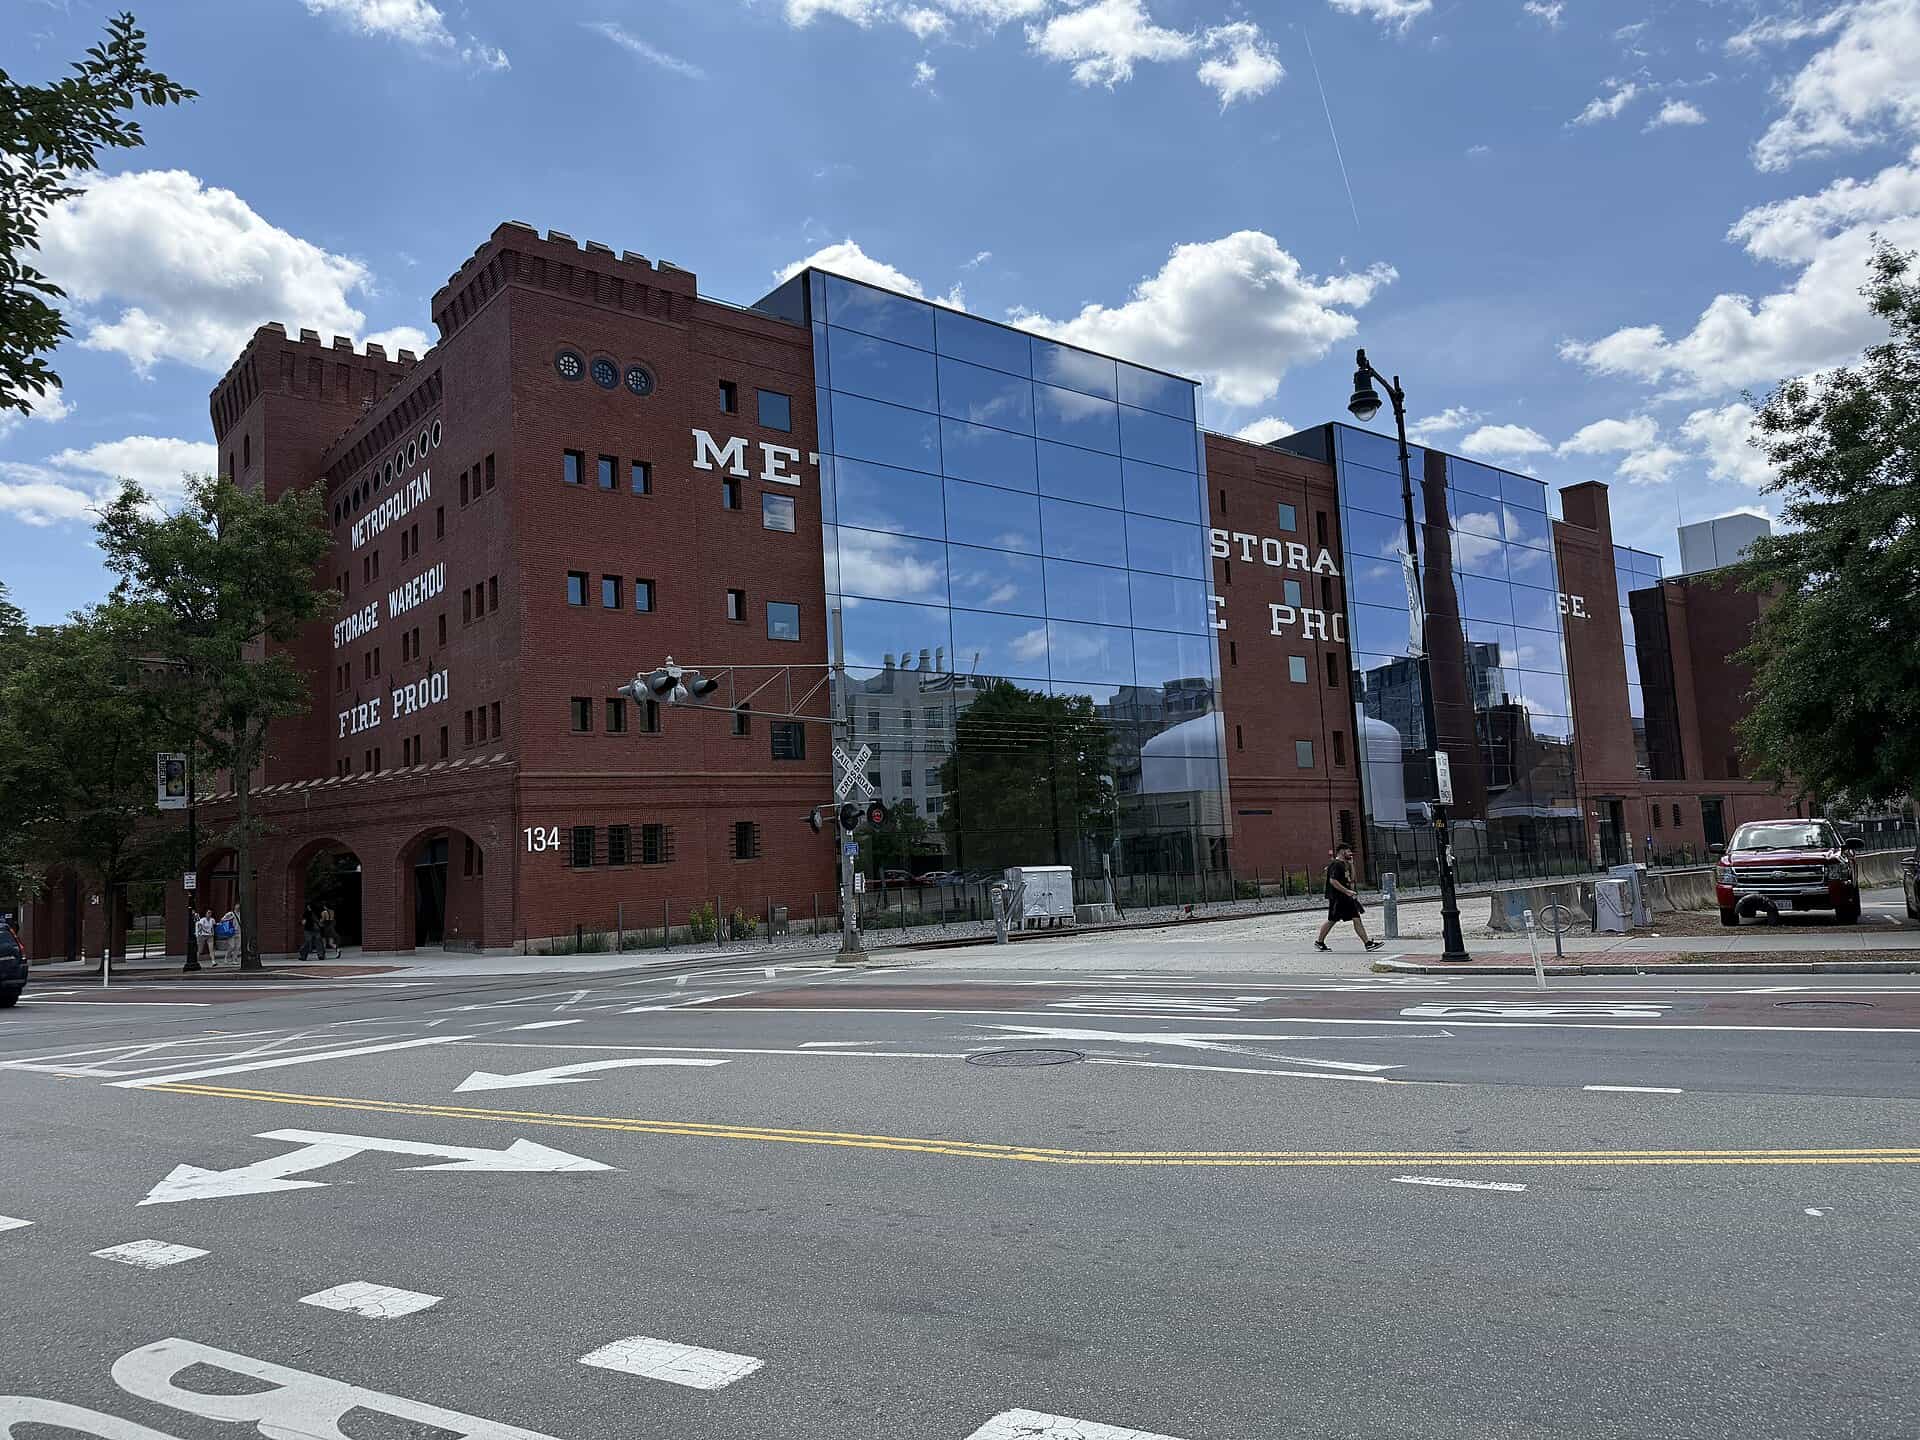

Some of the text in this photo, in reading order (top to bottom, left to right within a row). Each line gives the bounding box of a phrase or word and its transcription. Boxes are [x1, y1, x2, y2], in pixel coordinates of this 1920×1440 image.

[691, 428, 819, 486] ME
[352, 468, 432, 551] METROPOLITAN
[1210, 527, 1340, 577] STORA
[334, 561, 447, 648] STORAGE WAREHOU
[338, 697, 381, 739] FIRE
[834, 748, 851, 770] RAIL
[840, 750, 869, 795] CROSSING
[523, 826, 561, 852] 134
